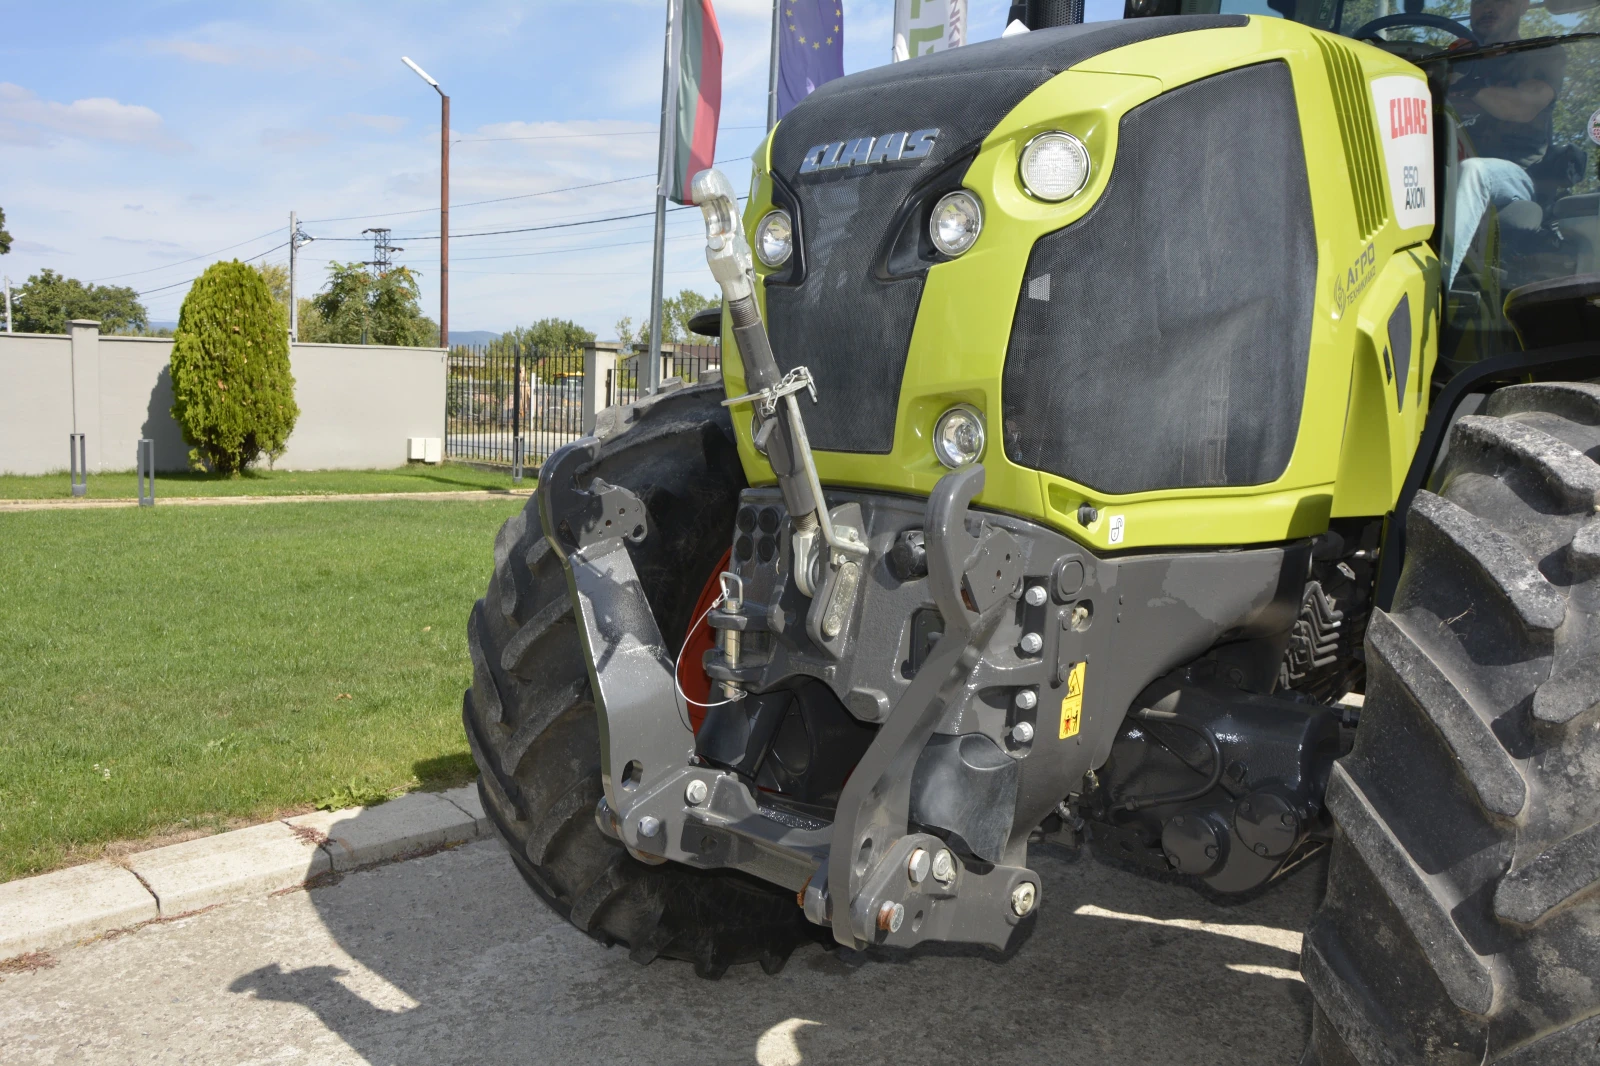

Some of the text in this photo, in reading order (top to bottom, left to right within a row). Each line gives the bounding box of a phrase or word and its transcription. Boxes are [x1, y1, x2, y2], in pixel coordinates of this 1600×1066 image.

[1389, 97, 1427, 139] CLAAS
[799, 127, 941, 174] CLAAS
[1403, 165, 1418, 187] 850
[1404, 187, 1426, 210] AXION
